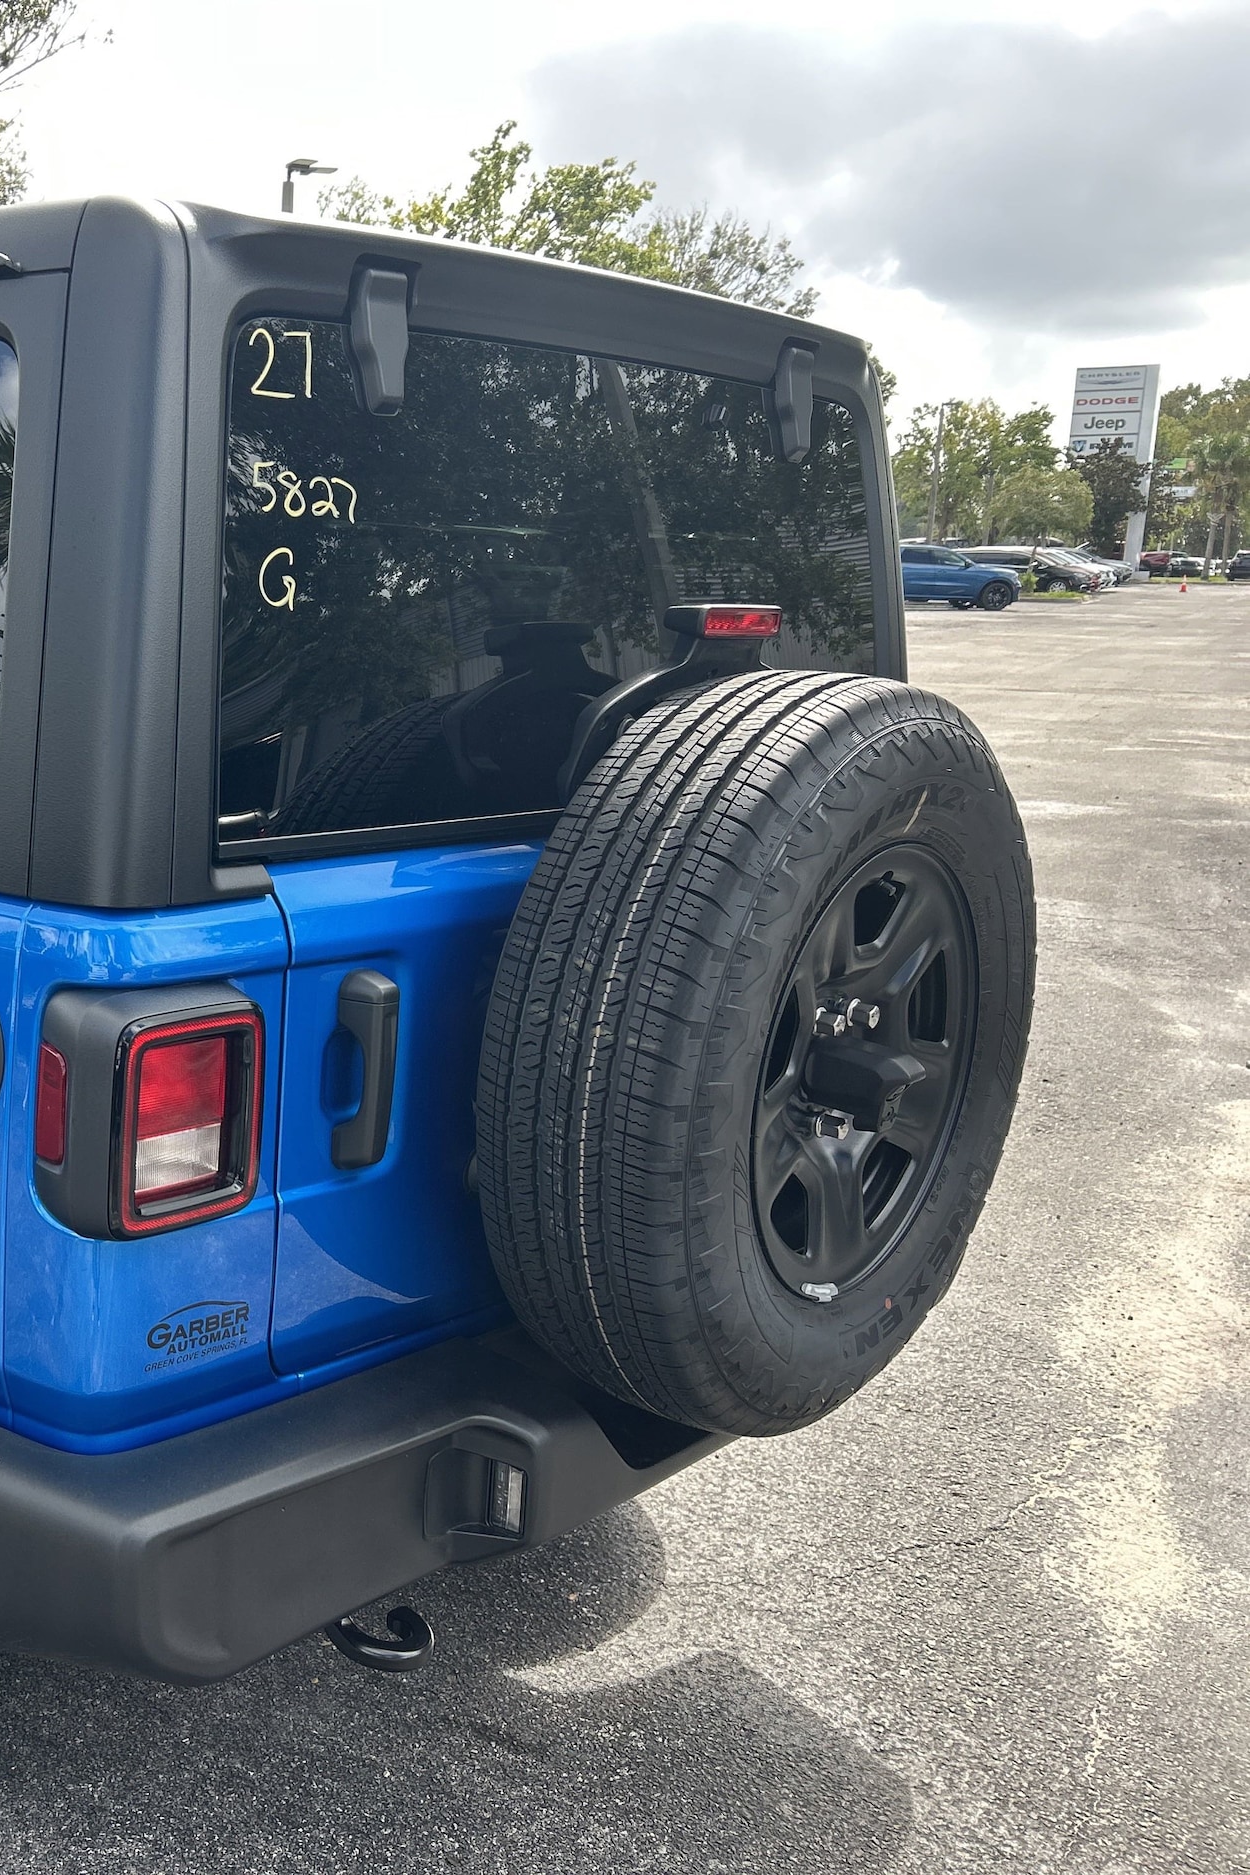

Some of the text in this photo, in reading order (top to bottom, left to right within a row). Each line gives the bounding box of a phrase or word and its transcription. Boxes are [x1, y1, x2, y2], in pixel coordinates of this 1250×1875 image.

[248, 327, 313, 399] 27
[1079, 371, 1141, 379] CHRYSLER
[1076, 396, 1140, 406] DODGE
[1083, 416, 1127, 431] Jeep
[252, 460, 358, 525] 5827
[258, 546, 296, 612] G
[147, 1305, 250, 1349] GARBER
[166, 1324, 248, 1355] AUTOMALL
[144, 1357, 175, 1372] GREEN
[176, 1351, 199, 1364] COVE
[238, 1337, 248, 1345] FL
